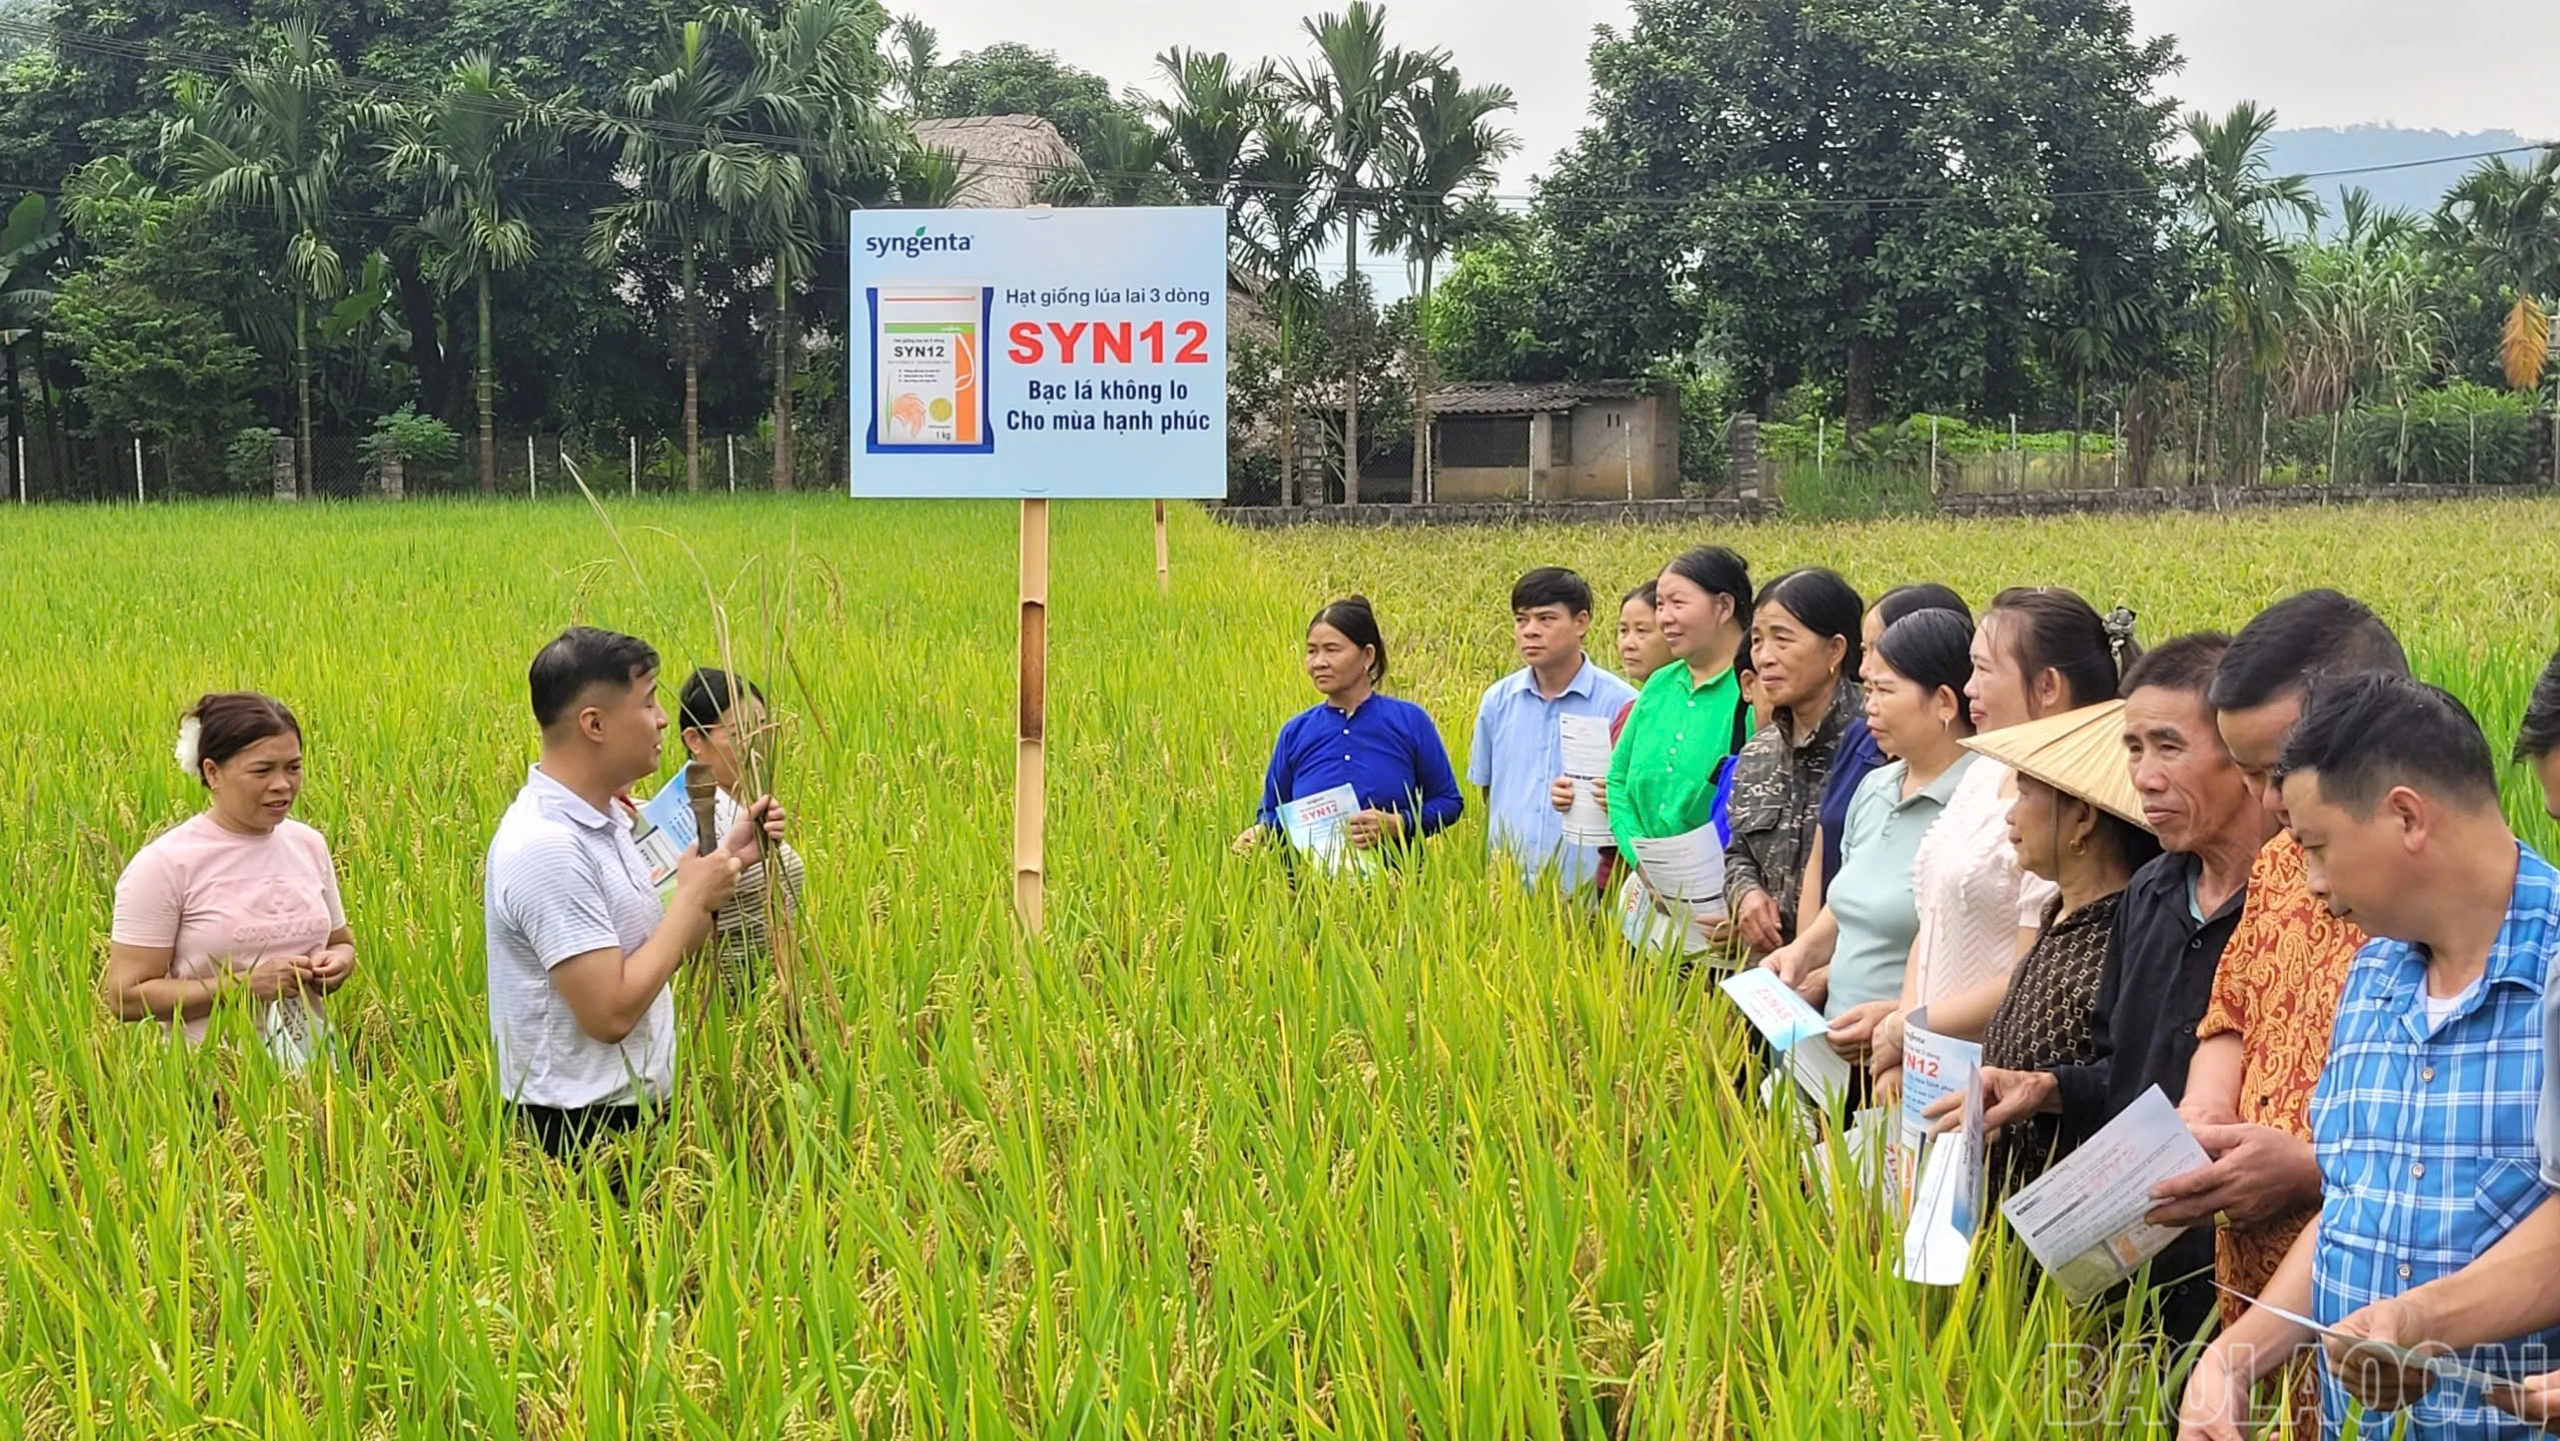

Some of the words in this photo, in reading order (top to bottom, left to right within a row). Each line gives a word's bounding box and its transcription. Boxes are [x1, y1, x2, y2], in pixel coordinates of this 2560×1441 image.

[866, 231, 971, 258] syngenta
[1006, 289, 1036, 308] Hạt
[1041, 286, 1090, 307] giống
[1095, 288, 1121, 303] lúa
[1126, 288, 1146, 303] lai
[1150, 288, 1161, 303] 3
[1165, 288, 1210, 306] dòng
[893, 345, 945, 358] SYN12
[1007, 320, 1209, 365] SYN12
[1029, 380, 1066, 405] Bạc
[1075, 379, 1093, 400] lá
[1101, 379, 1162, 404] không
[1170, 379, 1188, 400] lo
[1007, 410, 1045, 430] Cho
[1053, 410, 1095, 430] mùa
[1103, 410, 1153, 435] hạnh
[1161, 409, 1210, 435] phúc
[1301, 804, 1338, 822] SYN12
